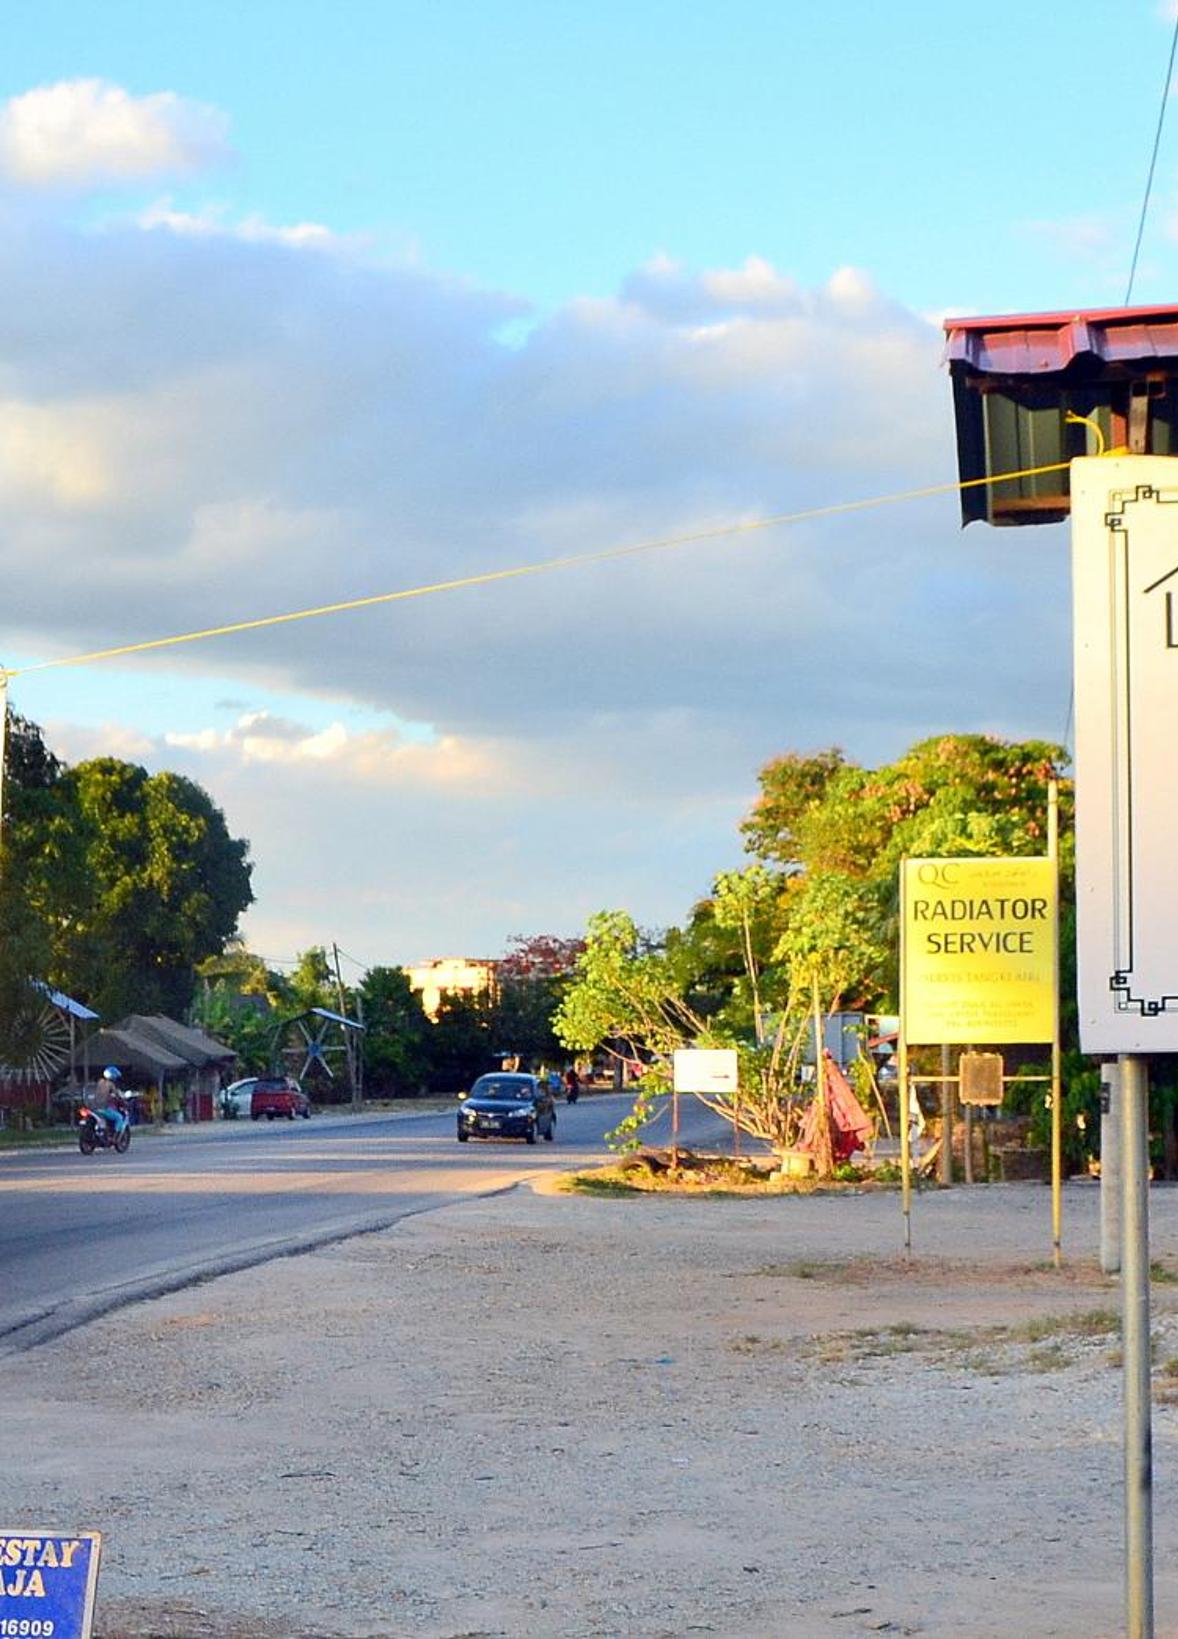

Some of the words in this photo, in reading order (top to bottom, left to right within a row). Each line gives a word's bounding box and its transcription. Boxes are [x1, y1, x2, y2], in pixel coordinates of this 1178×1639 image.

[913, 898, 1047, 921] RADIATOR
[926, 931, 1033, 954] SERVICE
[0, 1569, 46, 1597] JA
